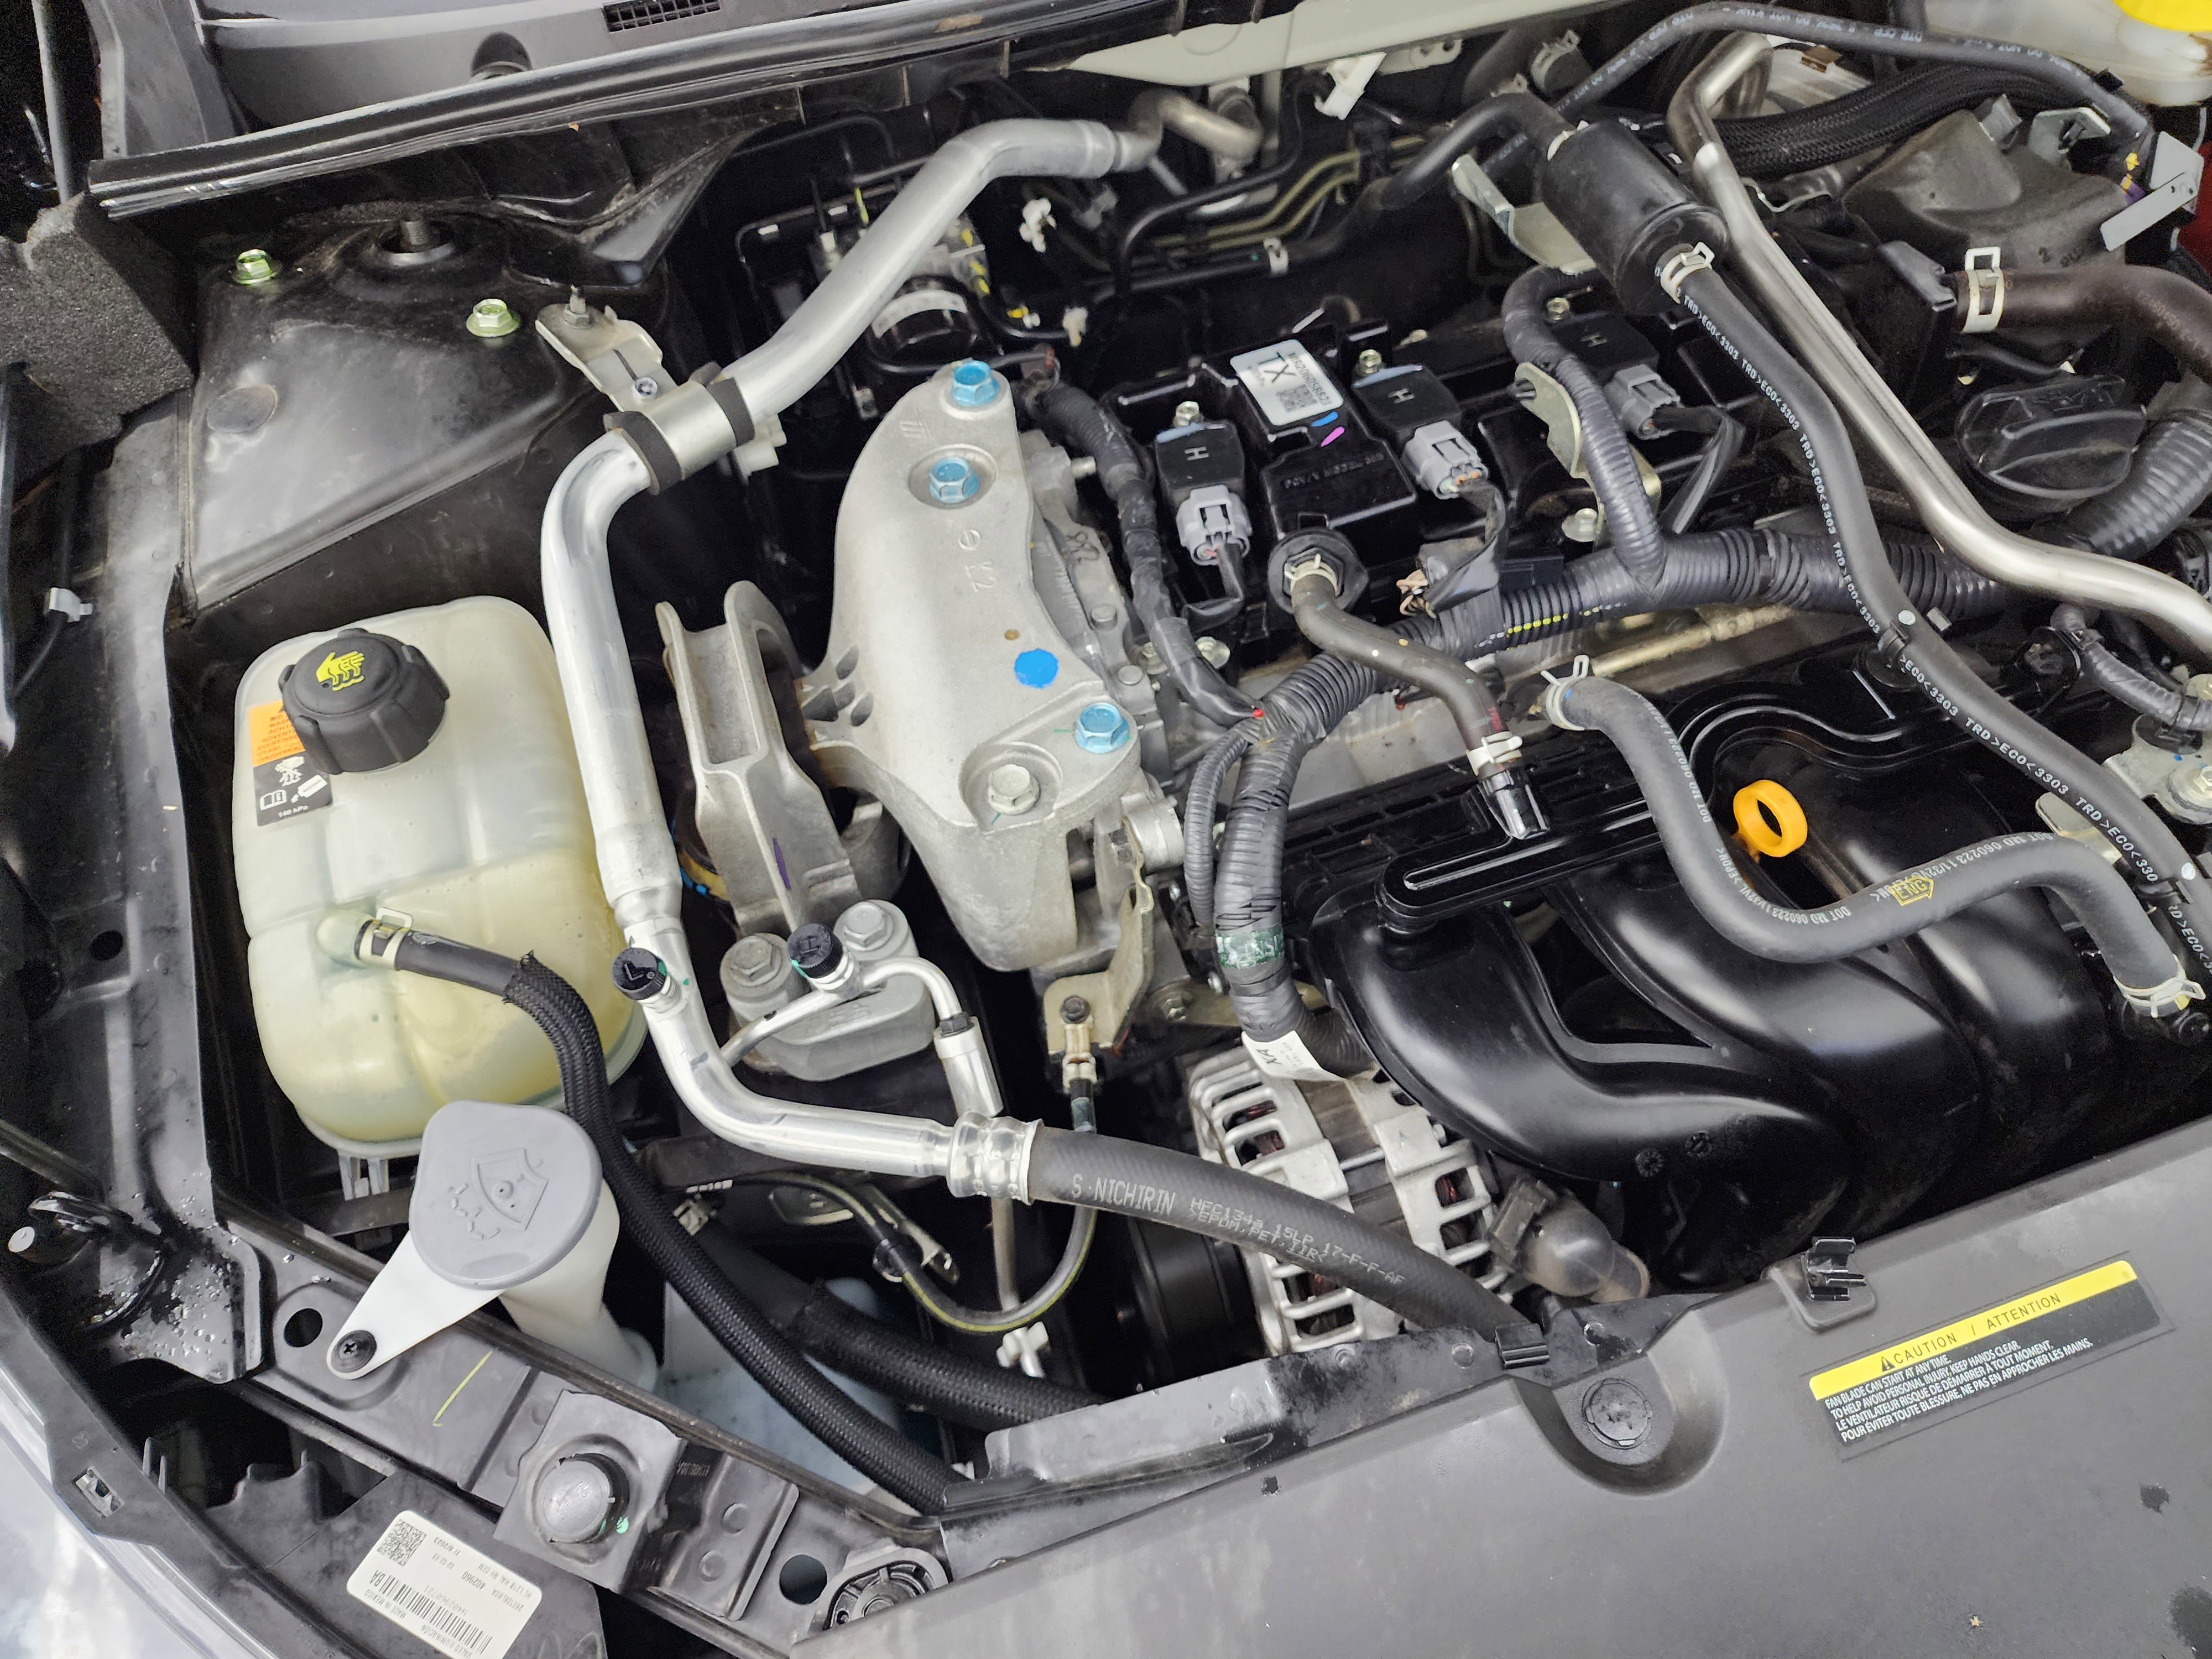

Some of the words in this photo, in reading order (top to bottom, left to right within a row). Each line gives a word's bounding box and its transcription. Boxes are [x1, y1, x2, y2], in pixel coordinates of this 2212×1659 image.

[1955, 842, 2002, 864] 060223
[2075, 797, 2159, 883] TRD>ECO<330
[1772, 907, 1808, 924] 060223
[1828, 905, 1851, 920] DOT
[1191, 1197, 1263, 1229] HFC134a
[1893, 1332, 1957, 1365] CAUTION
[1985, 1292, 2061, 1329] ATTENTION
[1824, 1394, 1843, 1410] FAN
[1840, 1385, 1866, 1404] BLADE
[1864, 1379, 1884, 1395] CAN
[1881, 1371, 1905, 1388] START
[1903, 1367, 1916, 1379] AT
[1913, 1360, 1932, 1376] ANY
[1930, 1353, 1952, 1370] TIME.
[1830, 1407, 1844, 1420] TO
[1842, 1400, 1863, 1416] HELP
[1861, 1391, 1886, 1408] AVOID
[1885, 1376, 1925, 1399] PERSONAL
[1922, 1366, 1952, 1385] INJURY,
[1949, 1359, 1969, 1375] KEEP
[1968, 1349, 1997, 1368] HANDS
[1994, 1340, 2021, 1358] CLEAR.
[1835, 1418, 1848, 1431] LE
[1845, 1397, 1901, 1427] VENTILATEUR
[1899, 1386, 1931, 1407] RISQUE
[1928, 1381, 1943, 1396] DE
[1941, 1365, 1987, 1391] DÉMARRER
[1985, 1363, 1994, 1374] À
[1991, 1354, 2015, 1372] TOUT
[2013, 1339, 2054, 1364] MOMENT.
[1840, 1423, 1867, 1442] POUR
[1864, 1413, 1895, 1433] ÉVITER
[1891, 1402, 1922, 1423] TOUTE
[1919, 1387, 1963, 1412] BLESSURE,
[1960, 1381, 1974, 1396] NE
[1972, 1375, 1990, 1391] PAS
[1988, 1371, 2002, 1385] EN
[2000, 1353, 2051, 1380] APPROCHER
[2048, 1347, 2065, 1363] LES
[2063, 1336, 2094, 1357] MAINS.
[370, 1569, 383, 1587] BA
[461, 1570, 487, 1590] 402960
[363, 1588, 385, 1605] MEXICO
[390, 1605, 407, 1619] MADE
